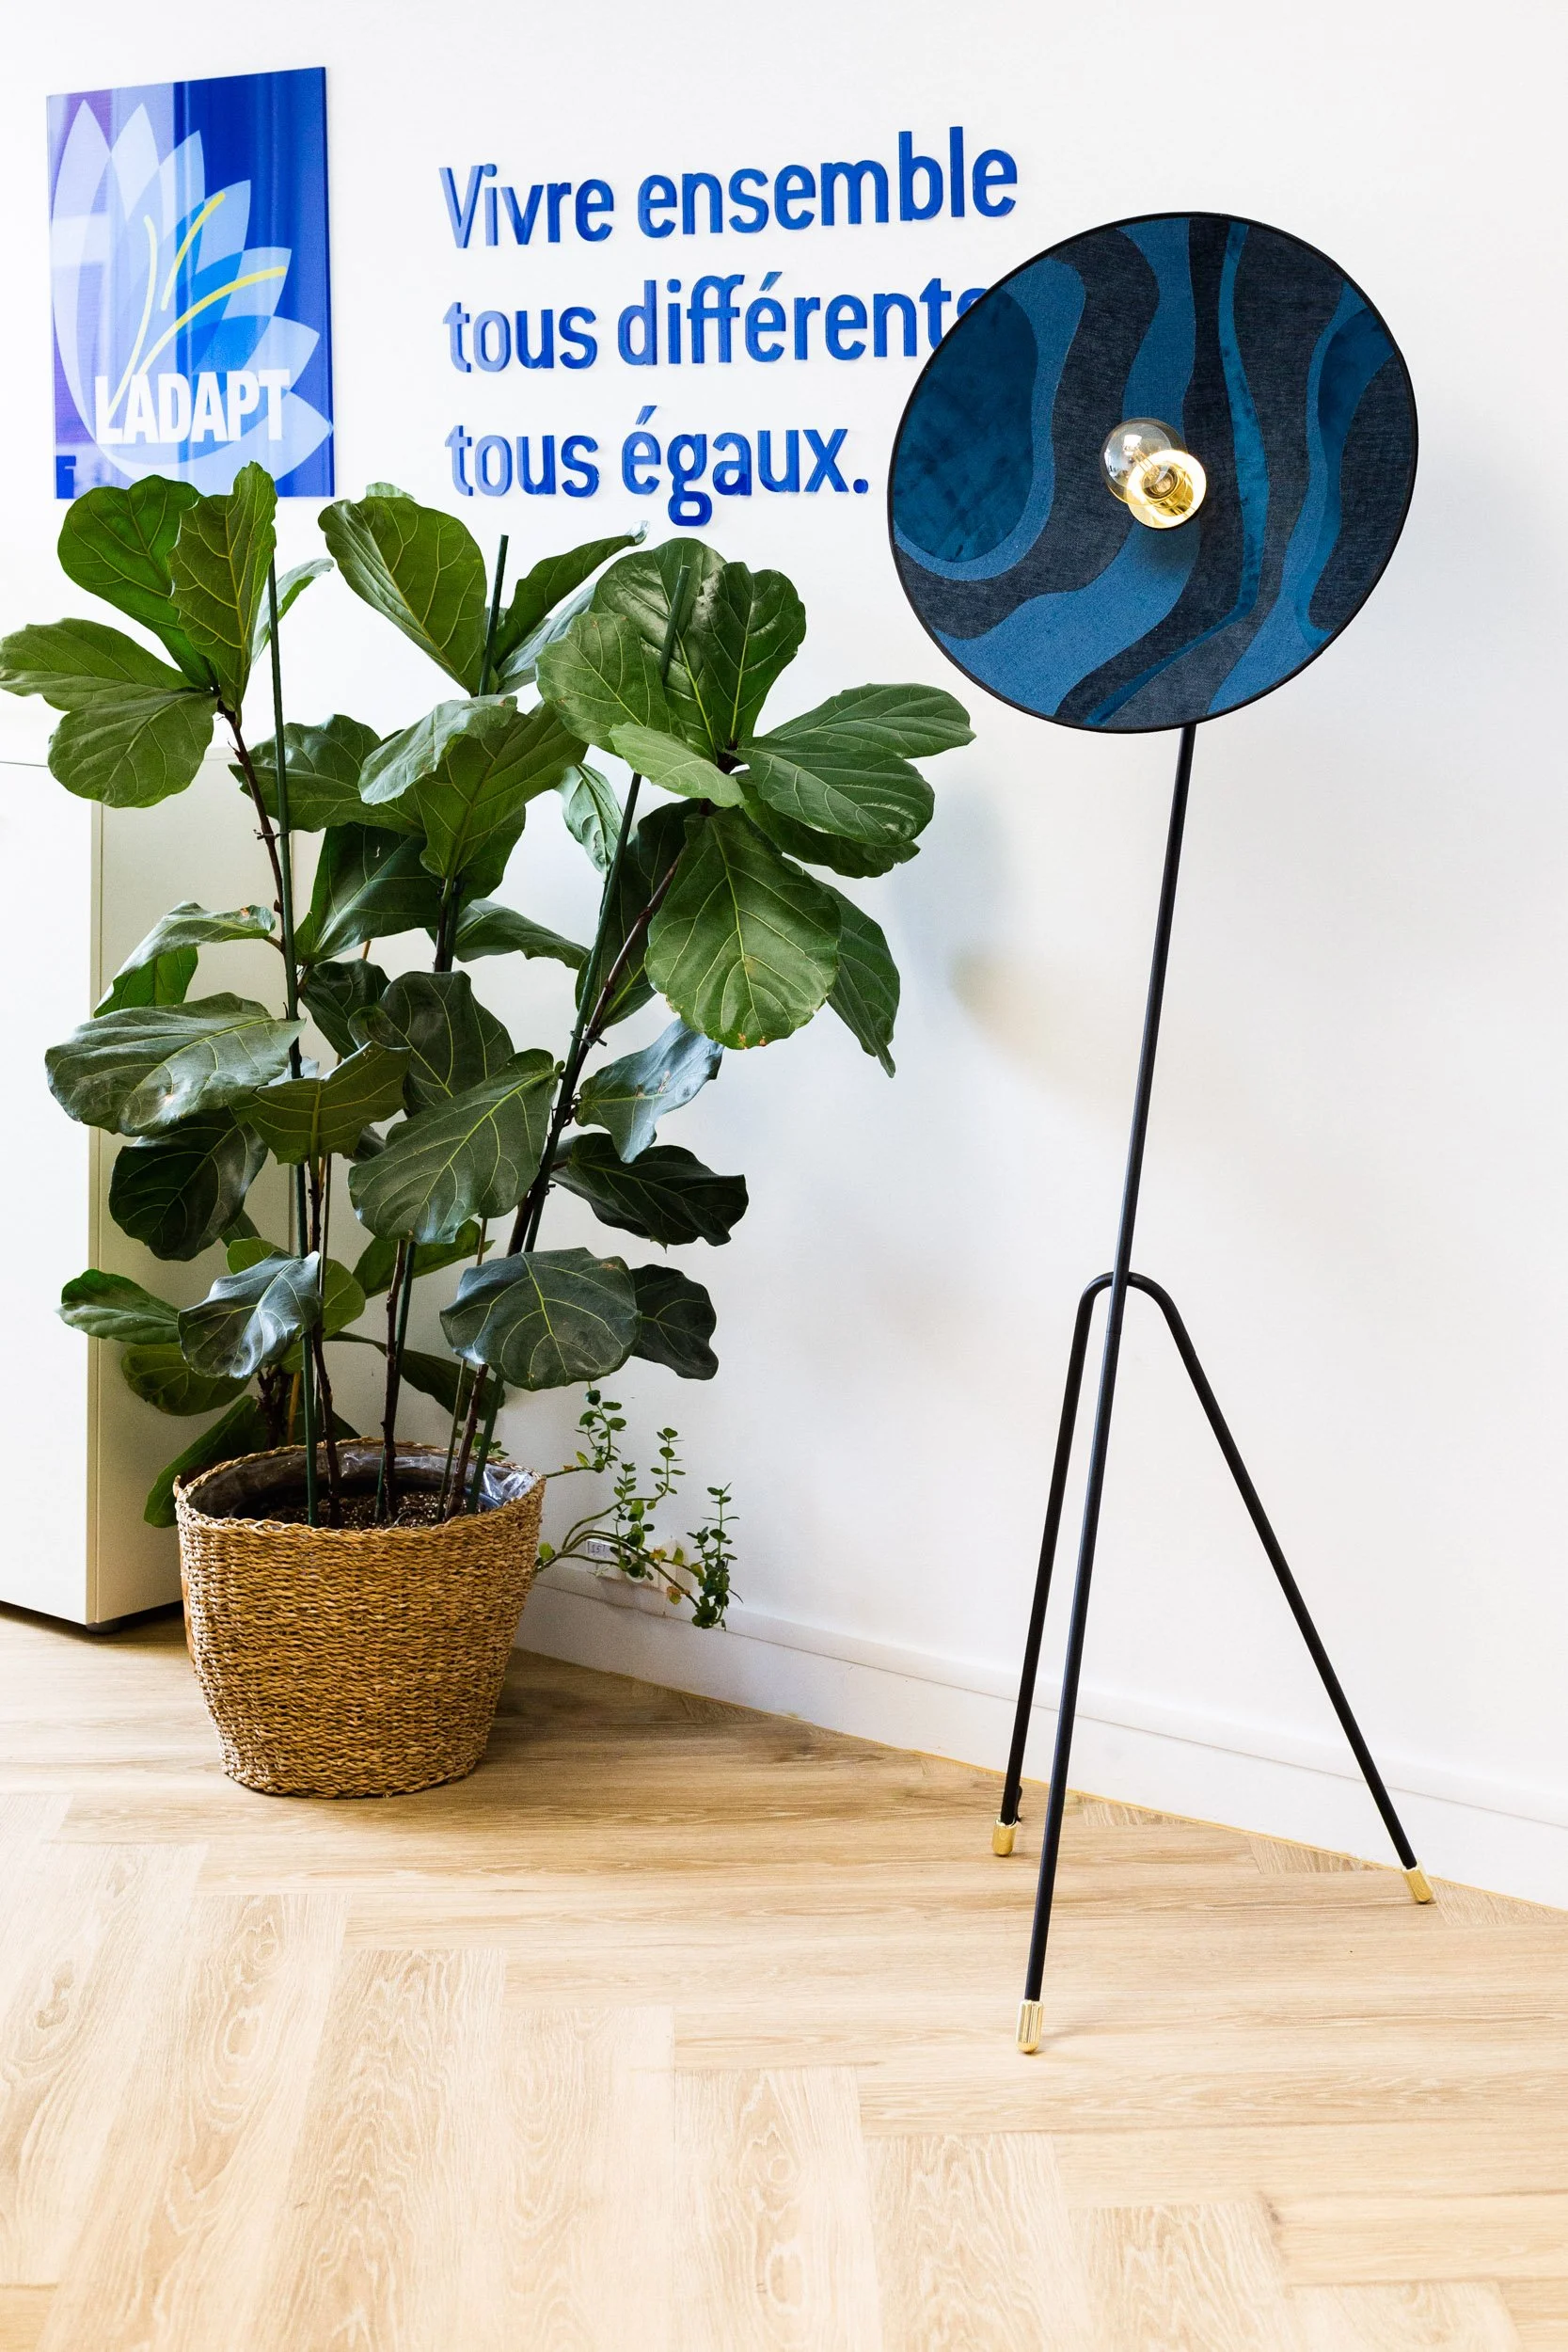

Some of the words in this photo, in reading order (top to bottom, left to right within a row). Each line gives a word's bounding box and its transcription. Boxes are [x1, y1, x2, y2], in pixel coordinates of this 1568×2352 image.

[439, 163, 614, 248] Vivre
[638, 125, 1018, 239] ensemble
[443, 302, 598, 373] tous
[446, 425, 600, 498] tous
[622, 405, 870, 527] égaux.
